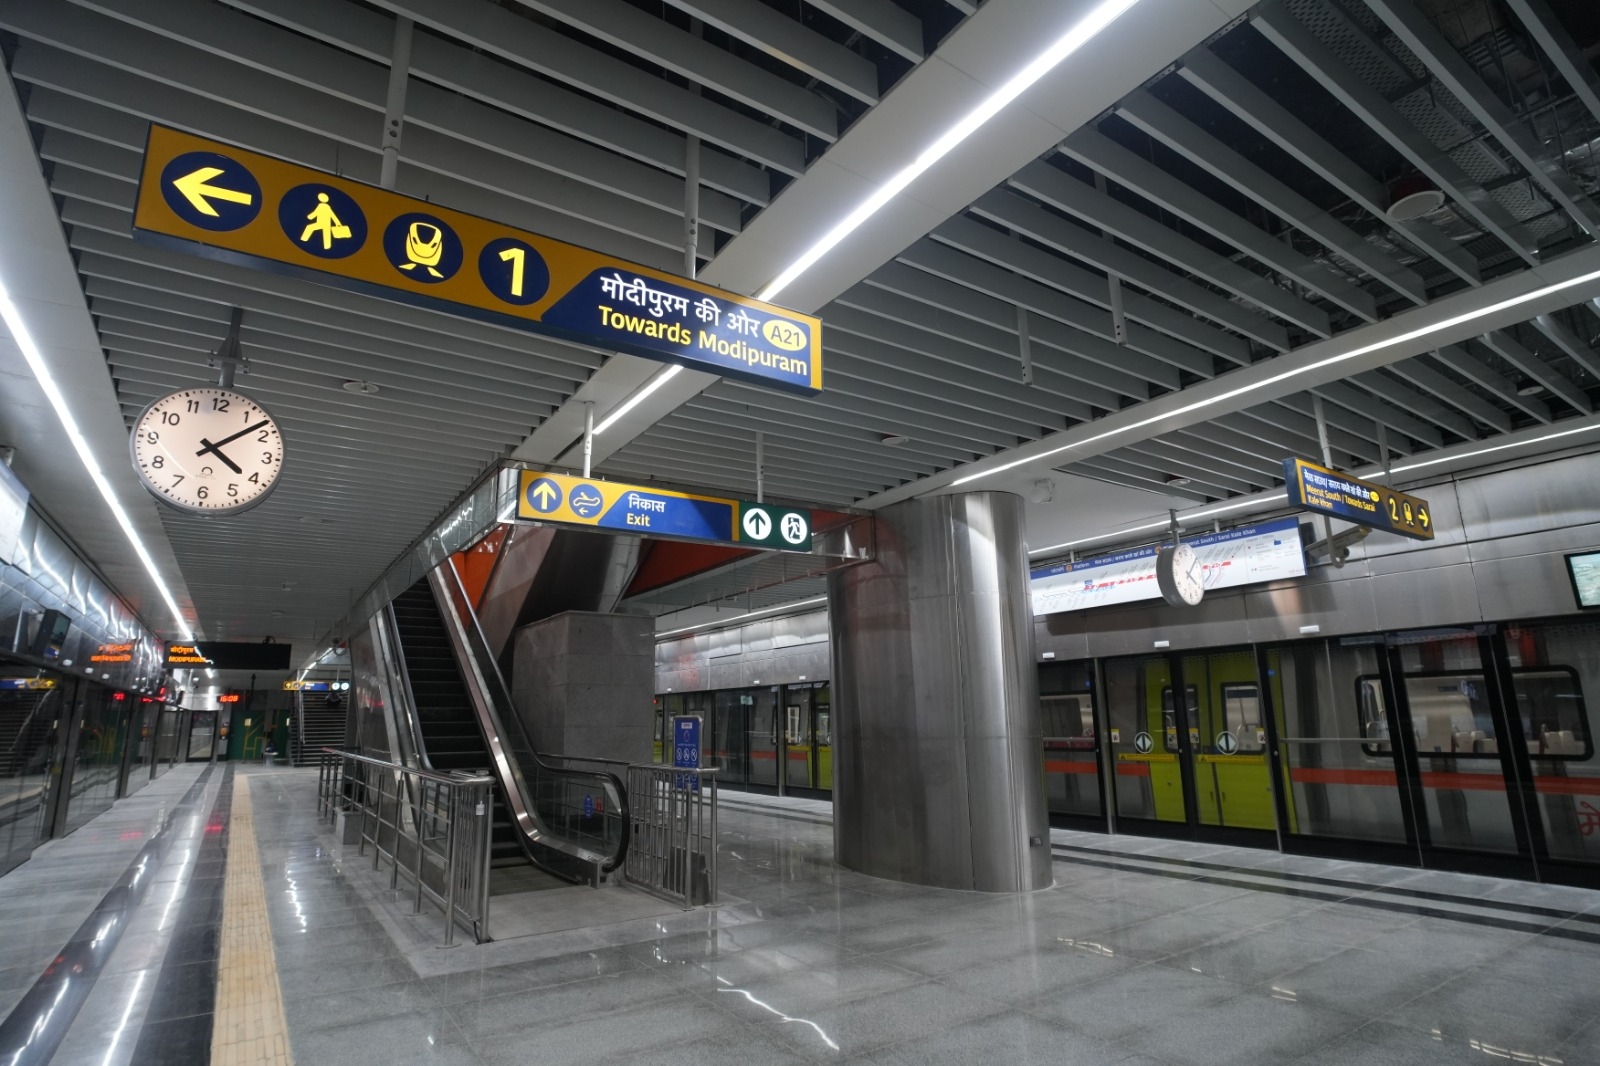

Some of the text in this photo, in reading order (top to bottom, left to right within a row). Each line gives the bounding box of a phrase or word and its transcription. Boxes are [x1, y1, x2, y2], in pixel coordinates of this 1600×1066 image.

[498, 247, 525, 297] 1
[600, 273, 761, 338] मोदीपुरम की ओर
[598, 305, 807, 376] Towards Modipuram
[770, 325, 801, 347] A21
[187, 400, 199, 414] 11
[212, 398, 230, 413] 12
[162, 411, 180, 426] 10
[243, 411, 249, 423] 1
[147, 431, 159, 444] 9
[257, 430, 269, 443] 2
[152, 456, 164, 469] 8
[261, 452, 272, 465] 3
[172, 474, 184, 488] 7
[248, 472, 260, 485] 4
[197, 486, 209, 499] 6
[227, 483, 238, 497] 5
[627, 493, 666, 513] निकास
[1306, 484, 1324, 497] Meerut
[1325, 489, 1341, 502] South
[1363, 502, 1376, 512] Sarai
[1389, 497, 1399, 521] 2
[626, 512, 651, 527] Exit
[1200, 535, 1214, 545] South
[1217, 533, 1230, 541] Sarai
[1231, 530, 1242, 538] Kale
[1243, 528, 1256, 536] Khan
[219, 695, 239, 703] 16:08
